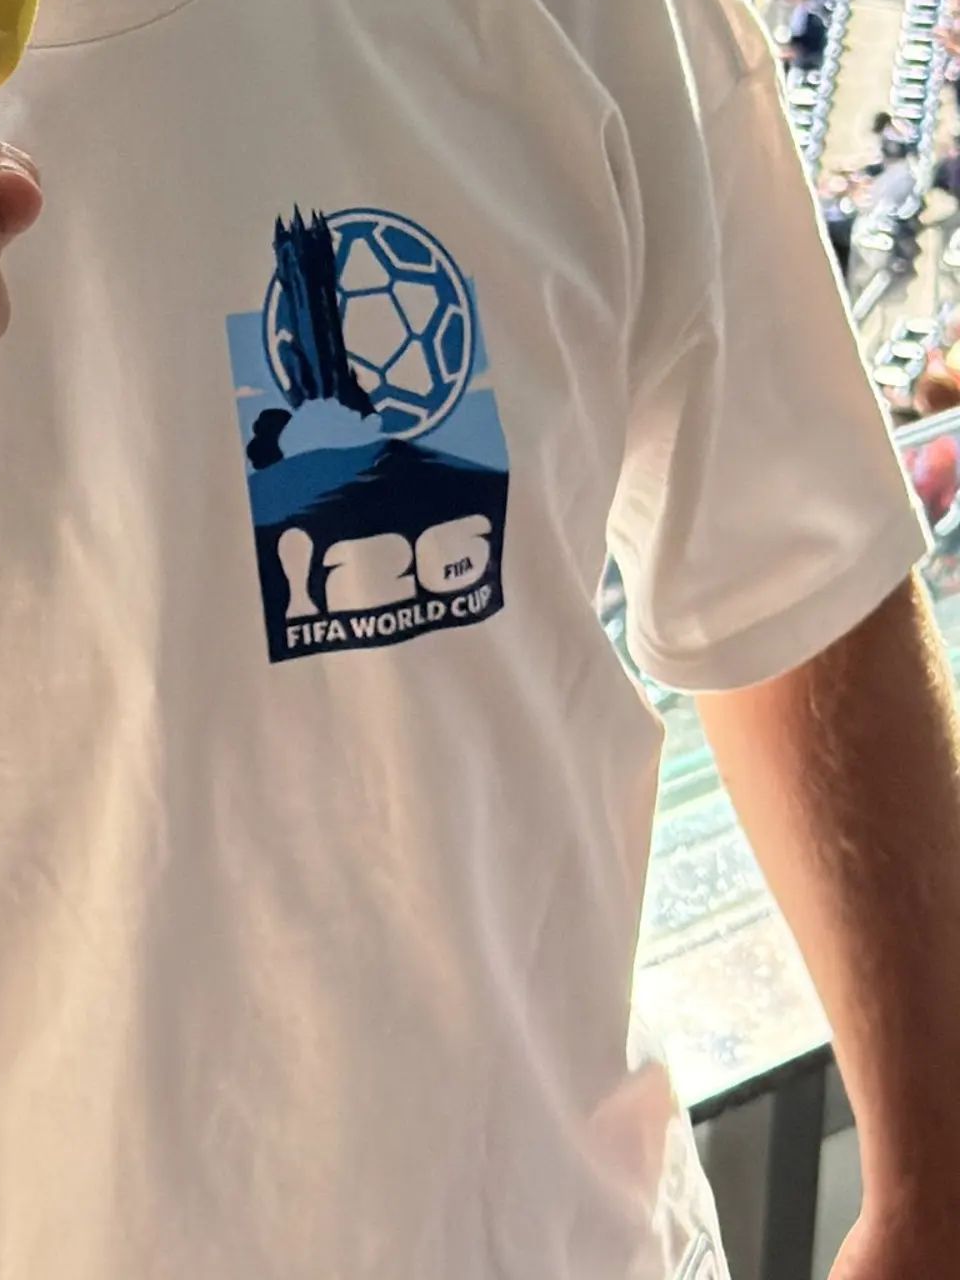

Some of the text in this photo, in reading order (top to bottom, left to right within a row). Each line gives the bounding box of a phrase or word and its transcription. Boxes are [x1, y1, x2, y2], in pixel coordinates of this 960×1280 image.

[443, 557, 473, 579] FIFA
[286, 585, 491, 649] FIFA WORLD CUP
